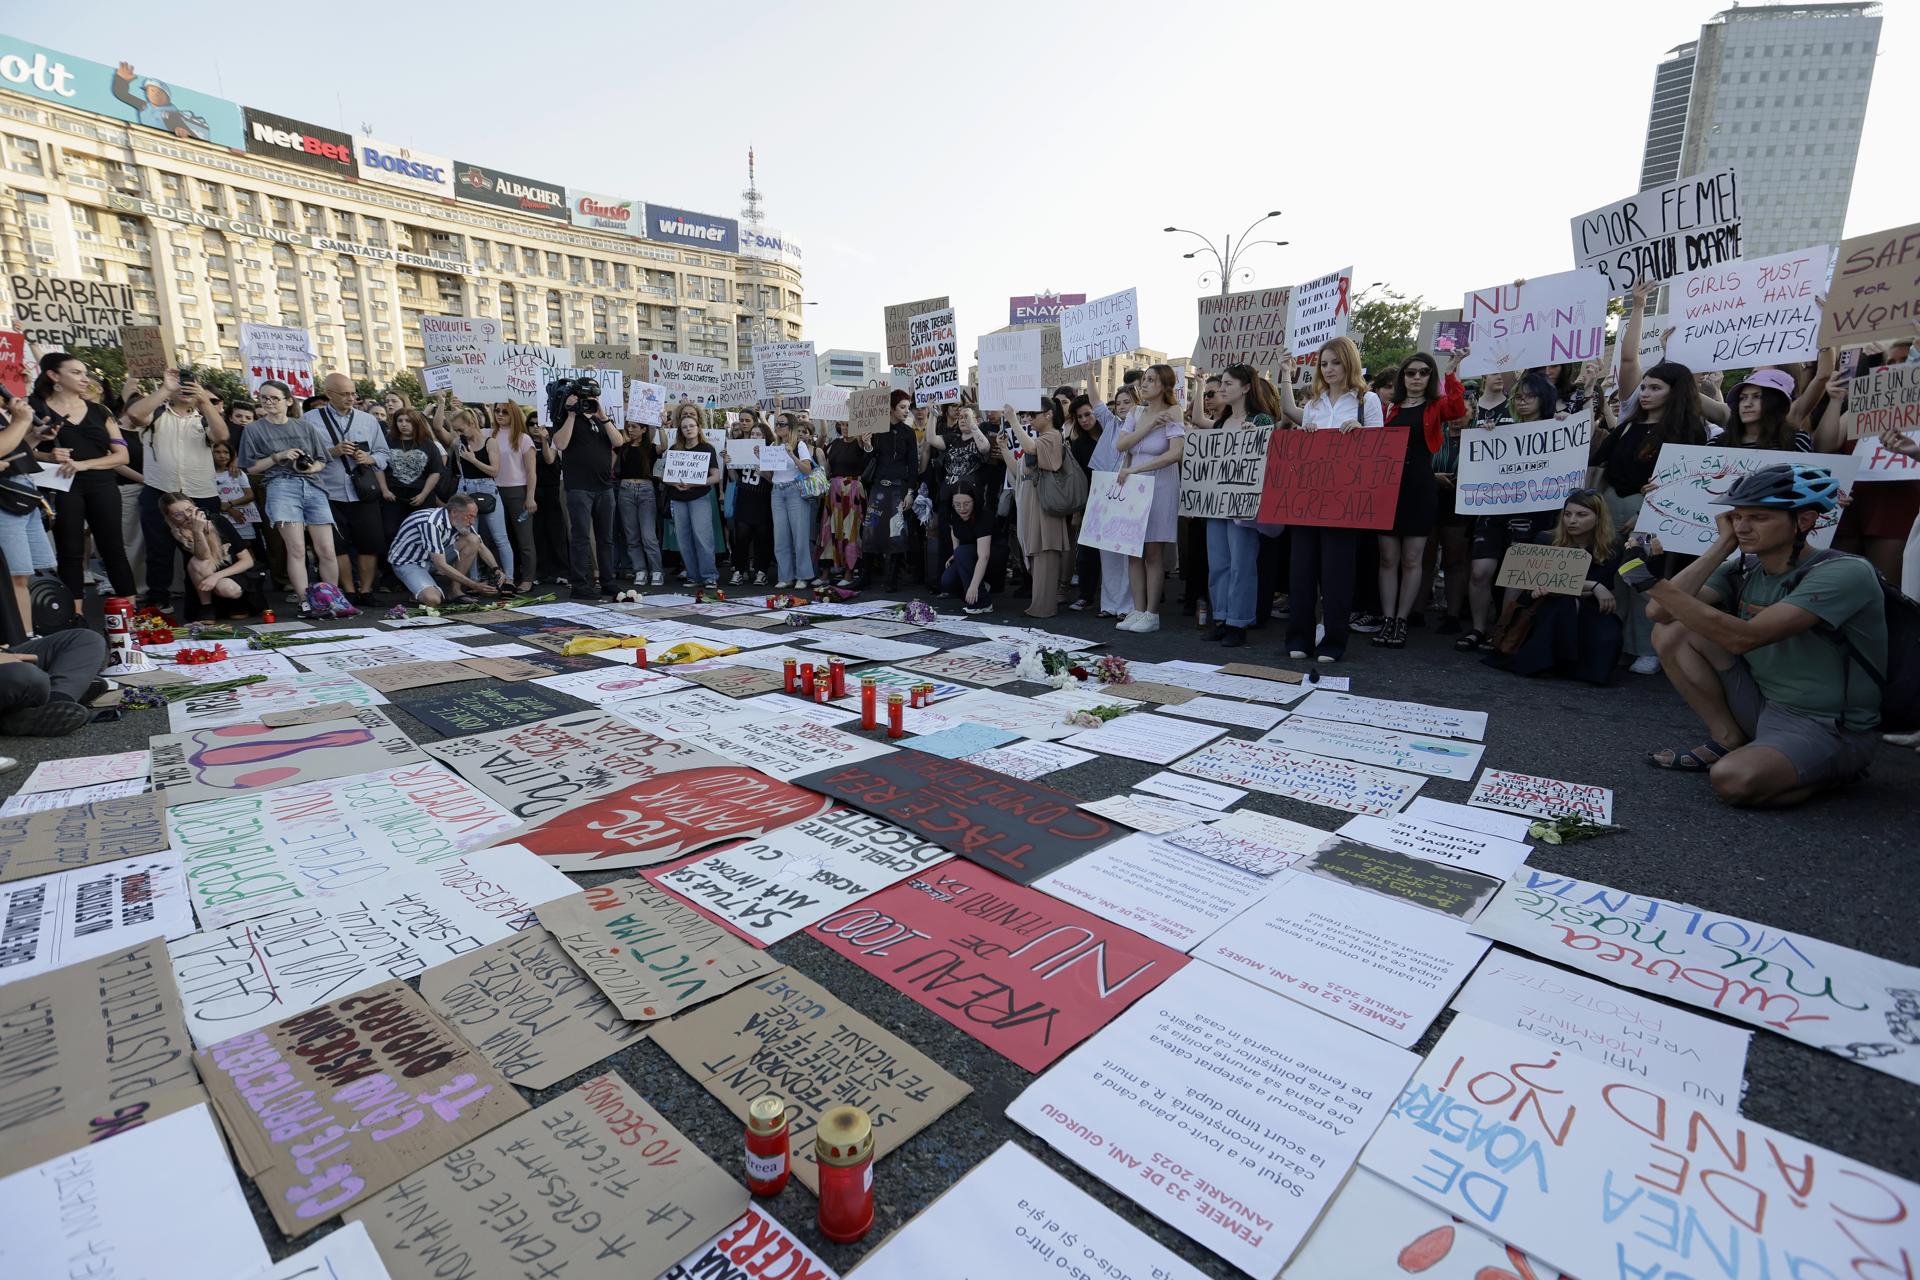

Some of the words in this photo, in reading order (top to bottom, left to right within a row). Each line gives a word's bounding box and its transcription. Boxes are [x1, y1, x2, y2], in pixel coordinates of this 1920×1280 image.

[252, 121, 352, 164] NetBet
[364, 146, 446, 185] BORSEC
[496, 178, 562, 207] ALBACHER
[579, 197, 630, 222] Giusto
[141, 201, 225, 232] EDENT
[229, 220, 300, 244] CLINIC
[594, 217, 627, 229] Natura
[659, 217, 725, 242] winner
[1581, 203, 1647, 253] MOR
[1617, 229, 1681, 285] STATUL
[1685, 221, 1742, 271] DOARME
[405, 255, 472, 274] FRUMUSETE
[1759, 258, 1810, 289] JUST
[1262, 290, 1290, 308] CHIAR
[1685, 298, 1746, 320] WANNA
[1764, 281, 1811, 302] HAVE
[1853, 281, 1891, 298] FOR
[16, 303, 42, 322] DE
[1016, 305, 1079, 317] ENAYA
[1064, 310, 1083, 328] BAD
[1088, 293, 1132, 319] BITCHES
[1472, 287, 1521, 318] NU
[1313, 316, 1337, 332] TIPAR
[1685, 306, 1815, 343] FUNDAMENTAL
[24, 329, 76, 346] CRED
[1236, 330, 1286, 348] FEMEILO
[615, 350, 630, 360] not
[938, 342, 955, 356] SAU
[507, 355, 536, 368] FUCK
[512, 367, 536, 376] THE
[660, 358, 672, 370] NU
[925, 371, 957, 386] CONTEZE
[1854, 377, 1870, 395] NU
[1888, 370, 1904, 390] UN
[1883, 391, 1897, 407] SE
[1186, 431, 1221, 458] SUTE
[1223, 432, 1240, 455] DE
[1469, 440, 1507, 462] END
[1513, 419, 1589, 455] VIOLENCE
[1183, 459, 1216, 481] SUNT
[1499, 460, 1549, 474] AGAINST
[1203, 493, 1218, 514] NU
[1219, 494, 1226, 514] E
[1460, 482, 1526, 505] TRANS
[1526, 559, 1543, 569] NU
[1567, 550, 1588, 560] MEA
[1506, 569, 1582, 590] FAVOARE
[156, 769, 191, 790] THIS
[1415, 836, 1480, 855] Believe
[1422, 829, 1486, 848] Protect
[1418, 846, 1462, 860] Hear
[938, 874, 974, 895] DA
[954, 892, 1042, 937] PENTRU
[817, 907, 930, 956] 1000
[603, 913, 705, 1000] VICTIMA
[950, 934, 1009, 960] DE
[1009, 924, 1154, 999] NU
[894, 950, 1058, 1046] VREAU
[1040, 1104, 1103, 1146] GIURGIU
[641, 1139, 681, 1167] 10
[1107, 1142, 1142, 1169] ANI,
[1141, 1166, 1165, 1186] DE
[1151, 1151, 1195, 1181] 2025
[1165, 1182, 1190, 1201] 33
[1193, 1177, 1274, 1231] IANUARIE
[1195, 1196, 1263, 1248] FEMEIE,
